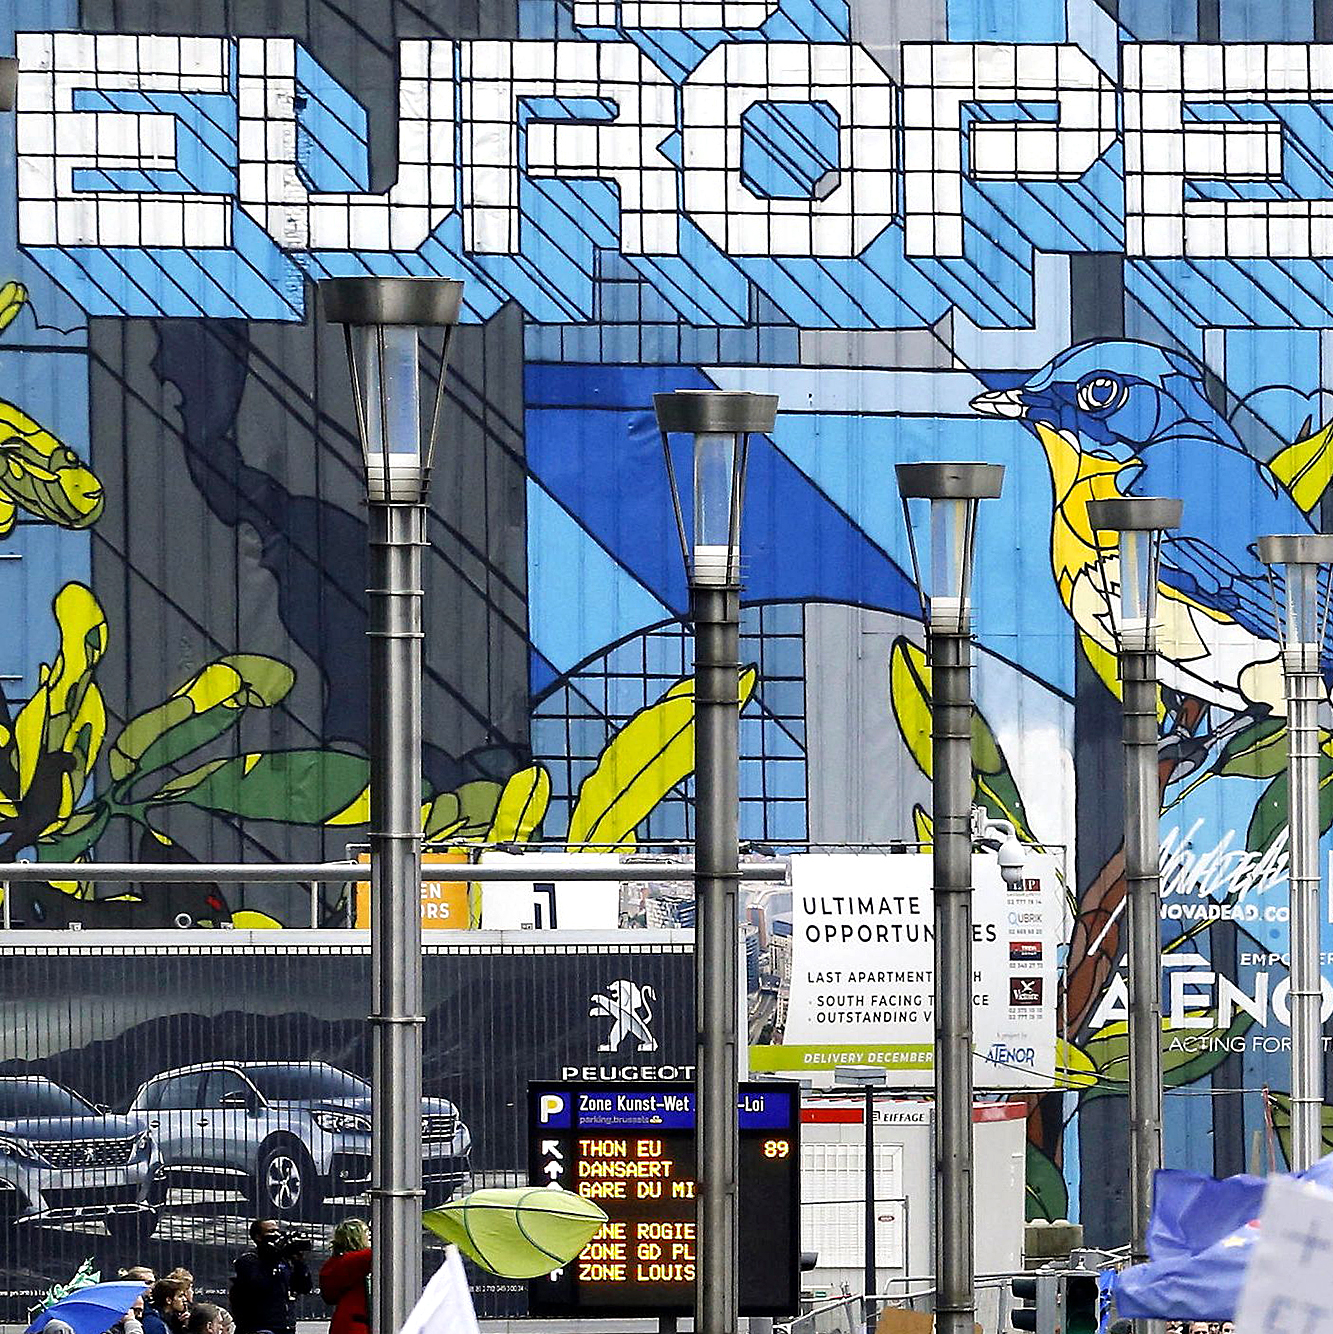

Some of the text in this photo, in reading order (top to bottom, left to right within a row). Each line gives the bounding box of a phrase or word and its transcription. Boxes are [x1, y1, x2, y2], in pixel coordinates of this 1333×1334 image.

[803, 897, 921, 915] ULTIMATE
[1160, 904, 1290, 922] NOVADEAD.CO
[805, 923, 998, 943] OPPORTUNES
[807, 971, 842, 983] LAST
[817, 995, 865, 1007] SOUTH
[871, 995, 922, 1006] FACING
[816, 1011, 918, 1024] OUTSTANDING
[1168, 1036, 1246, 1053] ACTING
[1252, 1036, 1292, 1053] FOR
[804, 1052, 934, 1064] DELIVERY DECEMBER
[562, 1066, 696, 1081] PEUGEOT
[540, 1095, 564, 1123] P
[579, 1095, 612, 1112] Zone
[617, 1095, 690, 1112] Kunst-Wet
[883, 1113, 925, 1122] EIFFAGE
[578, 1140, 790, 1158] THON EU 89
[578, 1160, 673, 1178] DANSAERT
[578, 1181, 695, 1199] GARE DU MI
[637, 1222, 696, 1240] ROGIE
[579, 1243, 627, 1261] ZONE
[637, 1243, 662, 1261] GD
[578, 1264, 696, 1282] ZONE LOUIS
